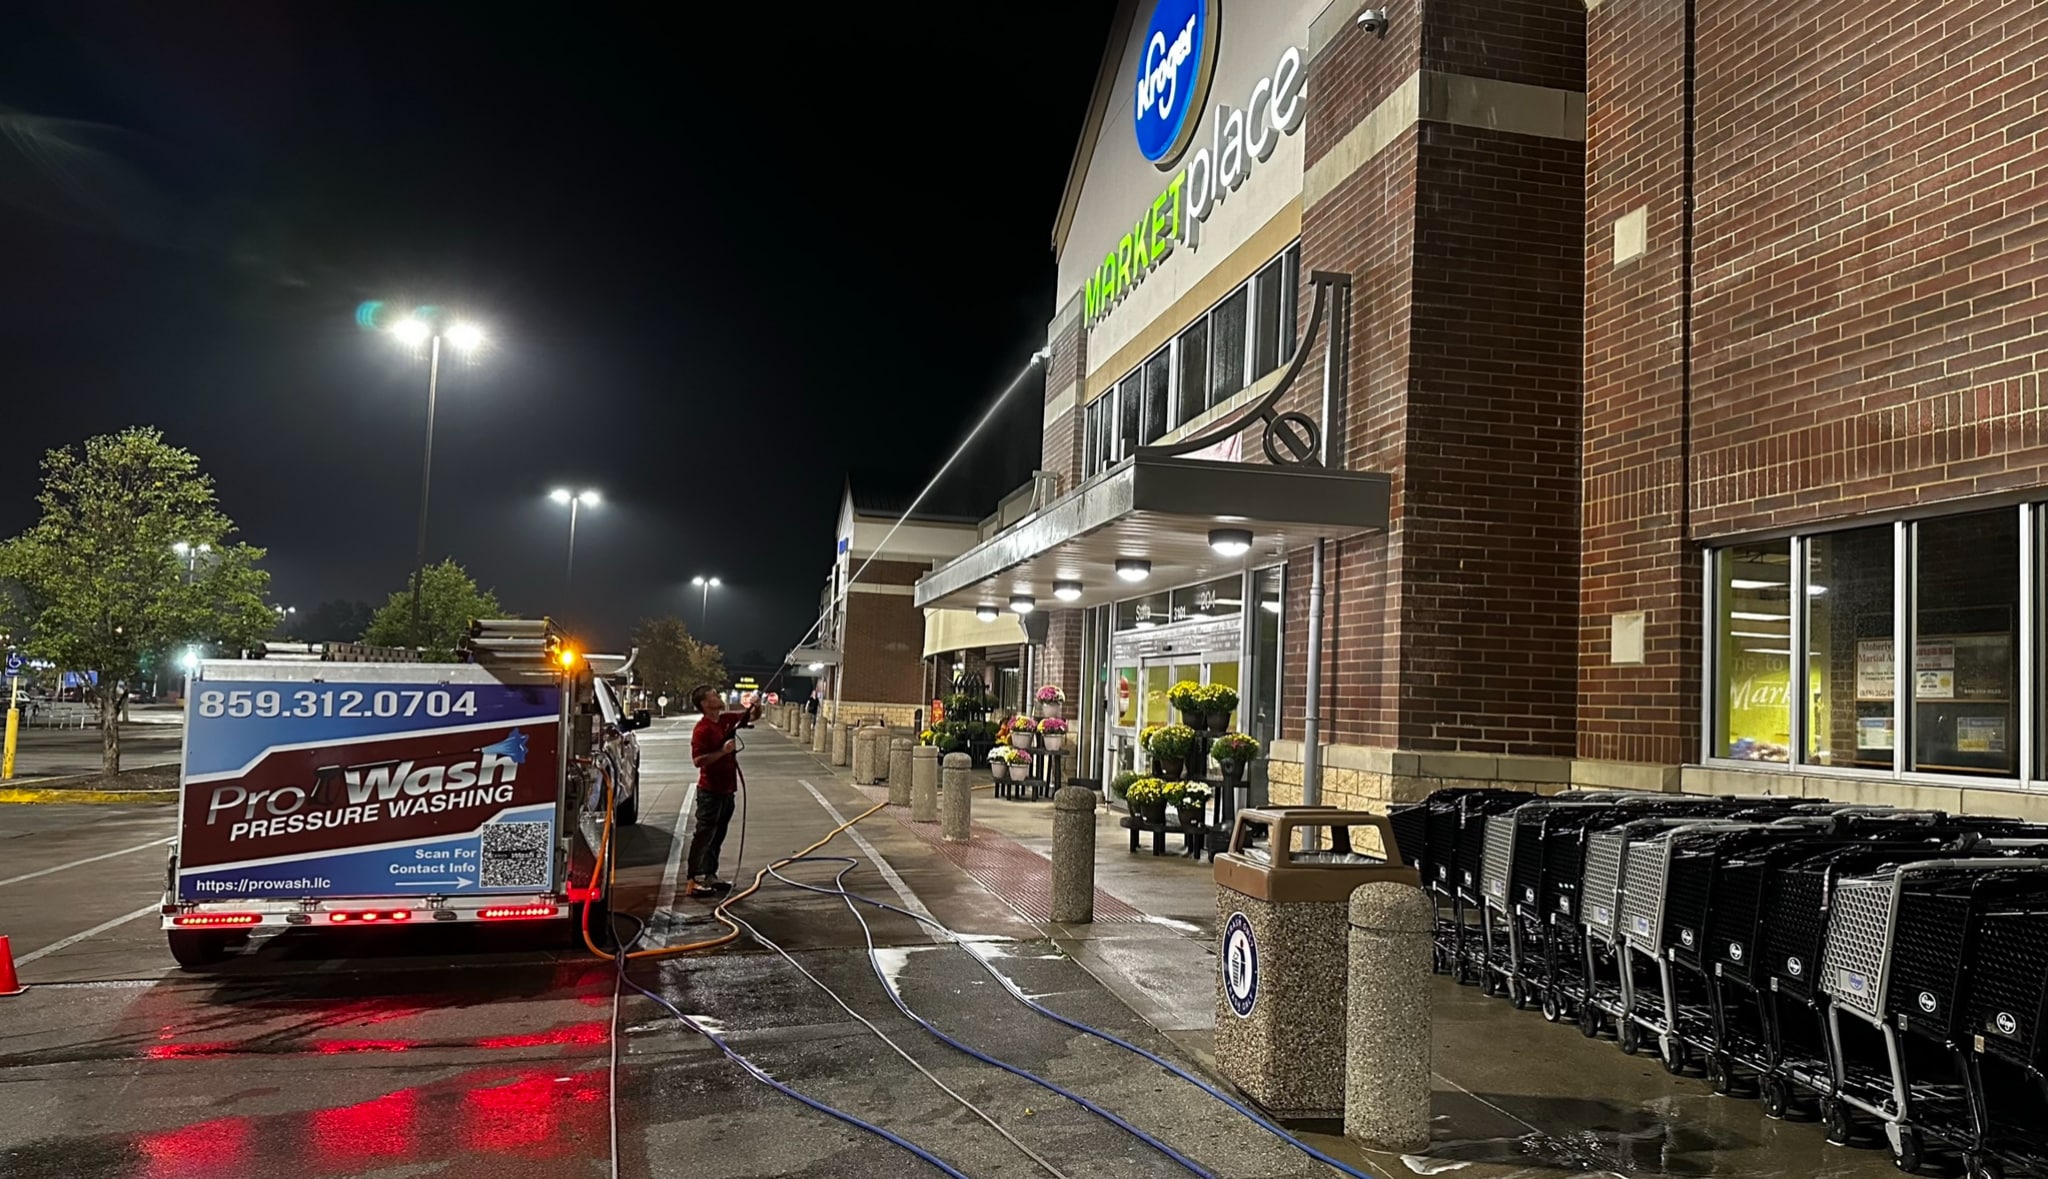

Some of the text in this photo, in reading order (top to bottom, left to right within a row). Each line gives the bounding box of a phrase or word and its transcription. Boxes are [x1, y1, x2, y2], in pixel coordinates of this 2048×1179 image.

[1137, 14, 1196, 120] Kroger
[199, 690, 477, 718] 859.312.0704
[207, 752, 519, 826] Pro Wash
[229, 784, 514, 842] PRESSURE WASHING
[389, 861, 476, 874] Contact Info
[415, 847, 477, 860] Scan For
[196, 876, 331, 892] https://prowash.llc
